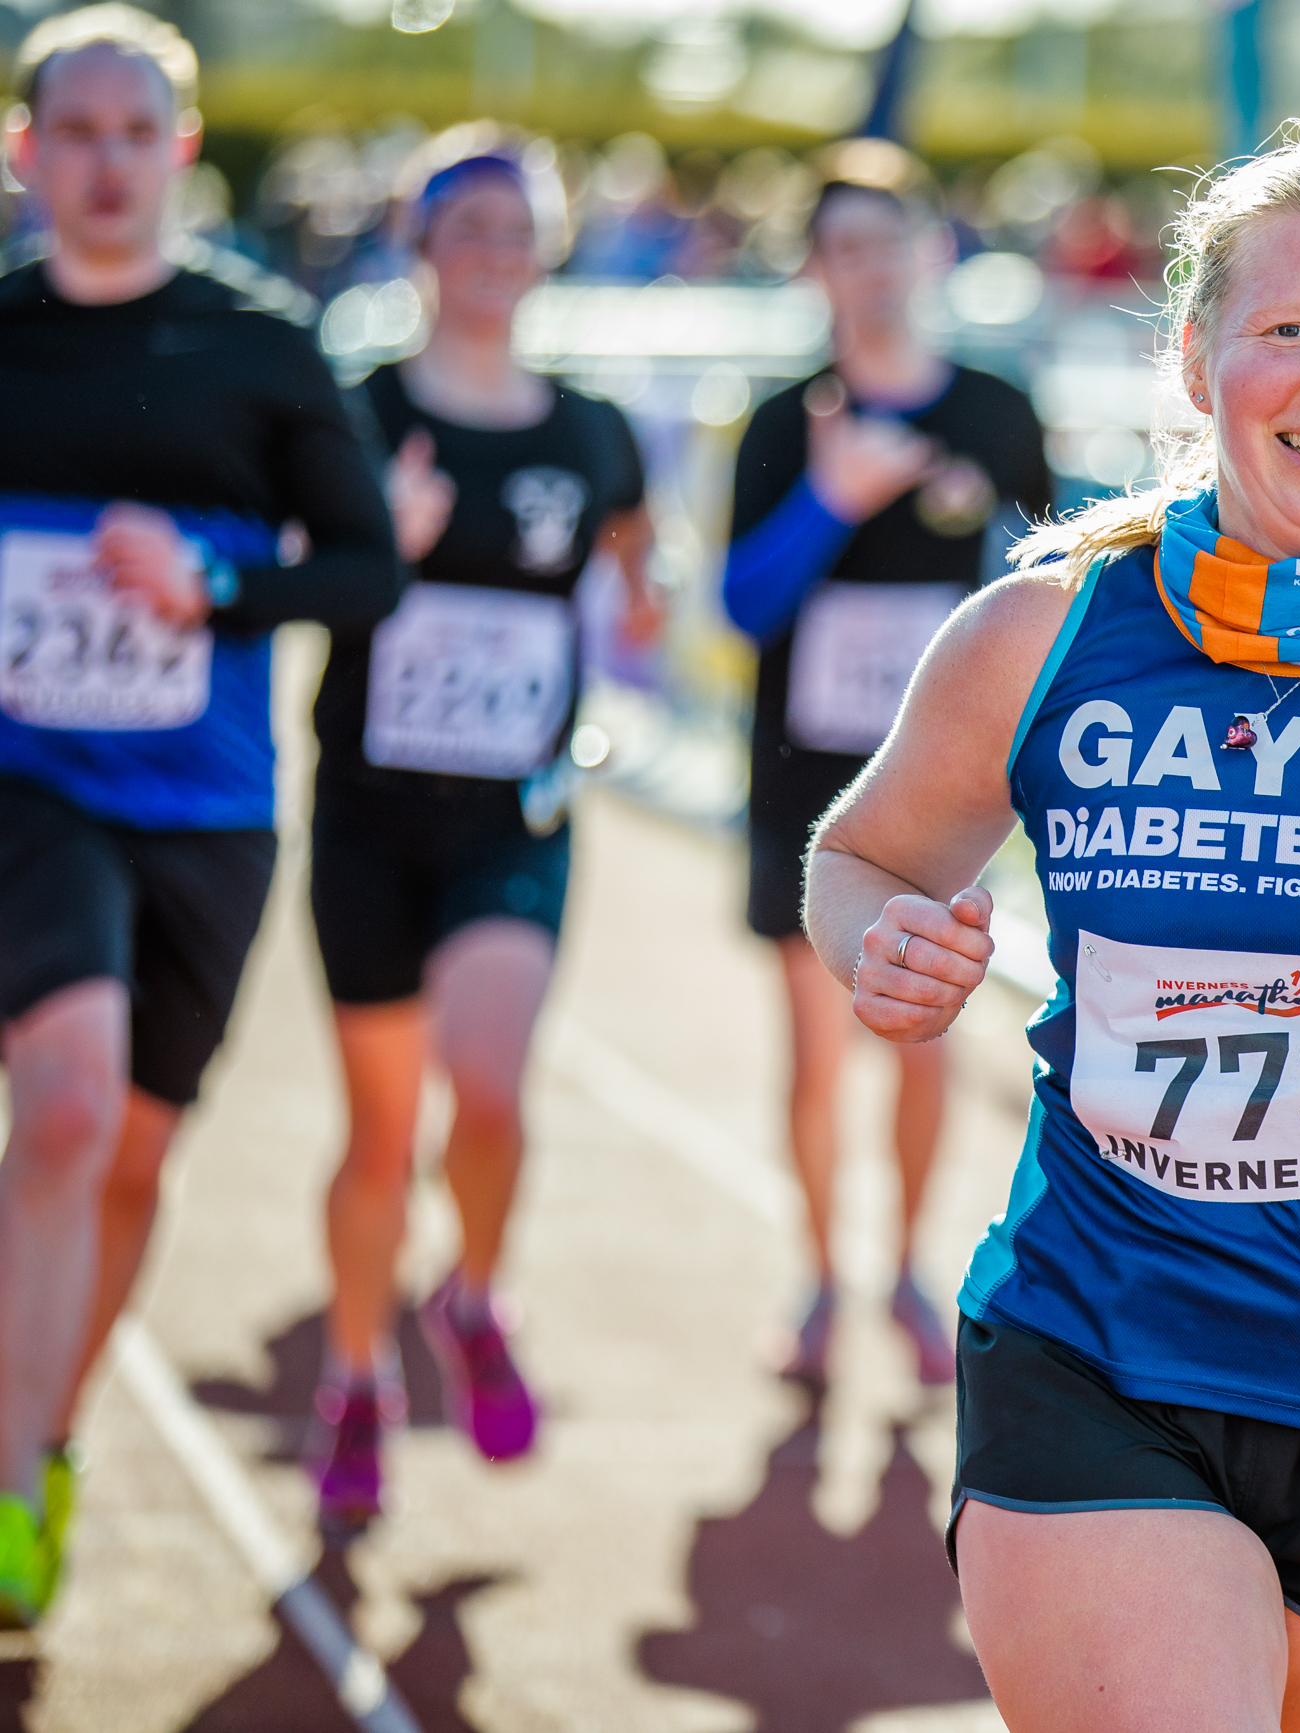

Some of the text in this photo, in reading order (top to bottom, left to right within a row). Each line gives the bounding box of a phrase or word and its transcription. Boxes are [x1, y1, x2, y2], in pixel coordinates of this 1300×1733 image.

[1048, 869, 1092, 892] KNOW
[1097, 868, 1247, 894] DIABETES.
[1156, 979, 1249, 991] INVERNESS
